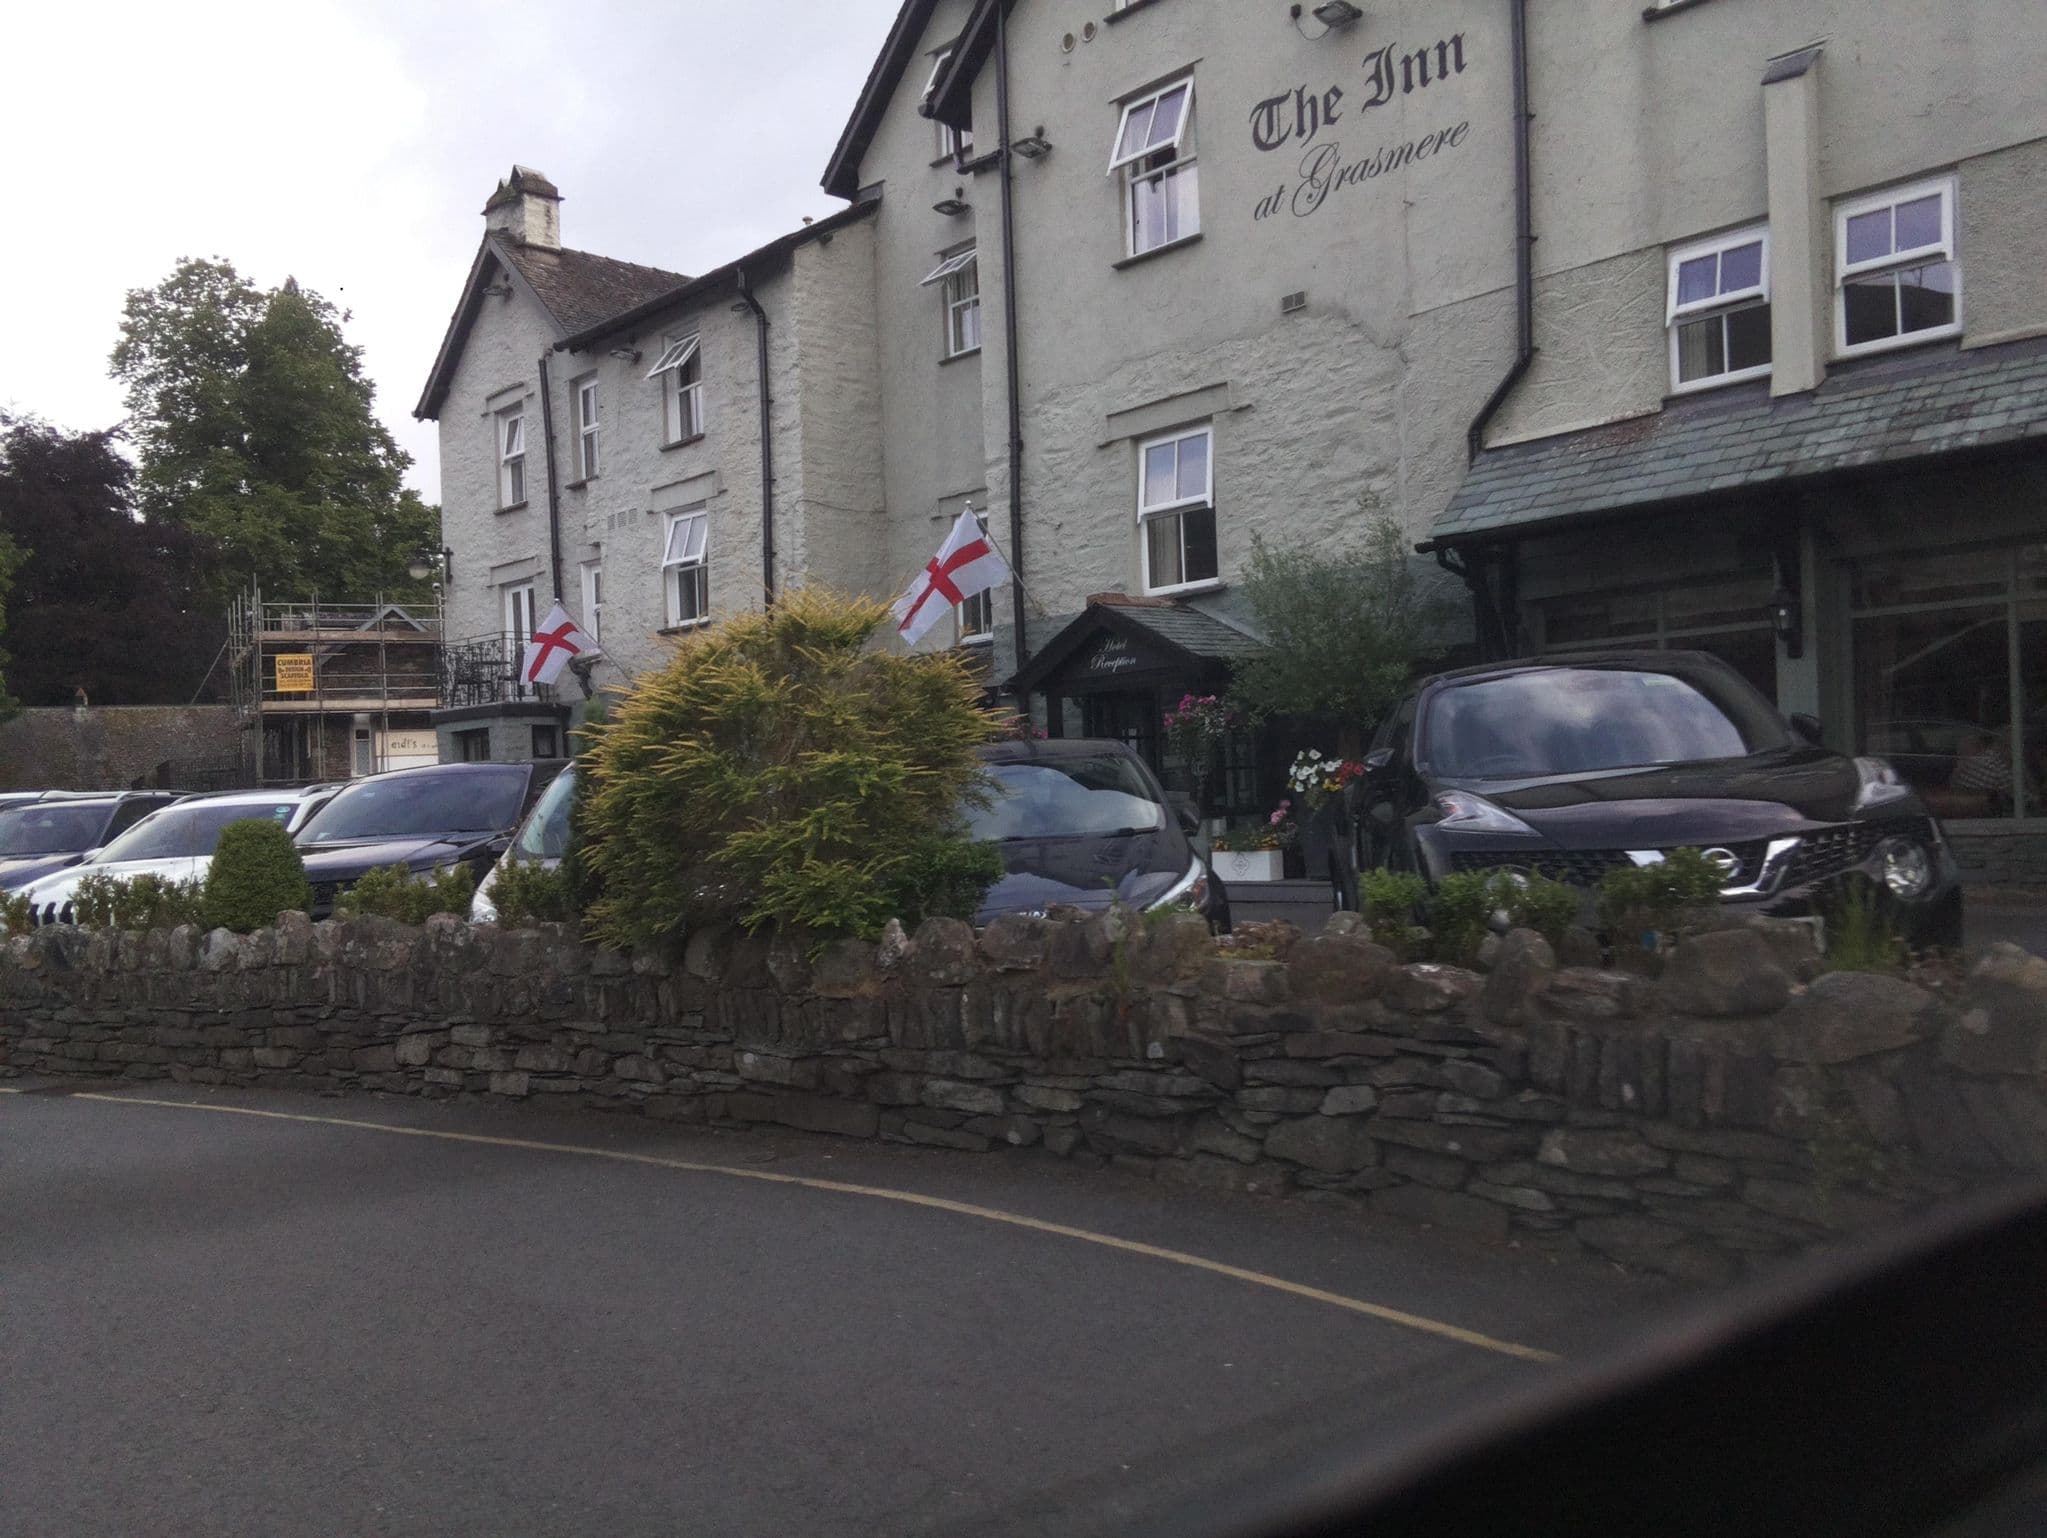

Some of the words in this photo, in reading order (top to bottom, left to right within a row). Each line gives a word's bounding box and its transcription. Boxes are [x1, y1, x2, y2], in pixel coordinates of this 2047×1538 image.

[1249, 84, 1344, 151] The
[1361, 32, 1467, 113] Inn
[1254, 185, 1285, 221] at
[1292, 121, 1470, 218] Grasmere
[277, 658, 312, 666] CUMBRIA
[1090, 653, 1137, 673] Reception
